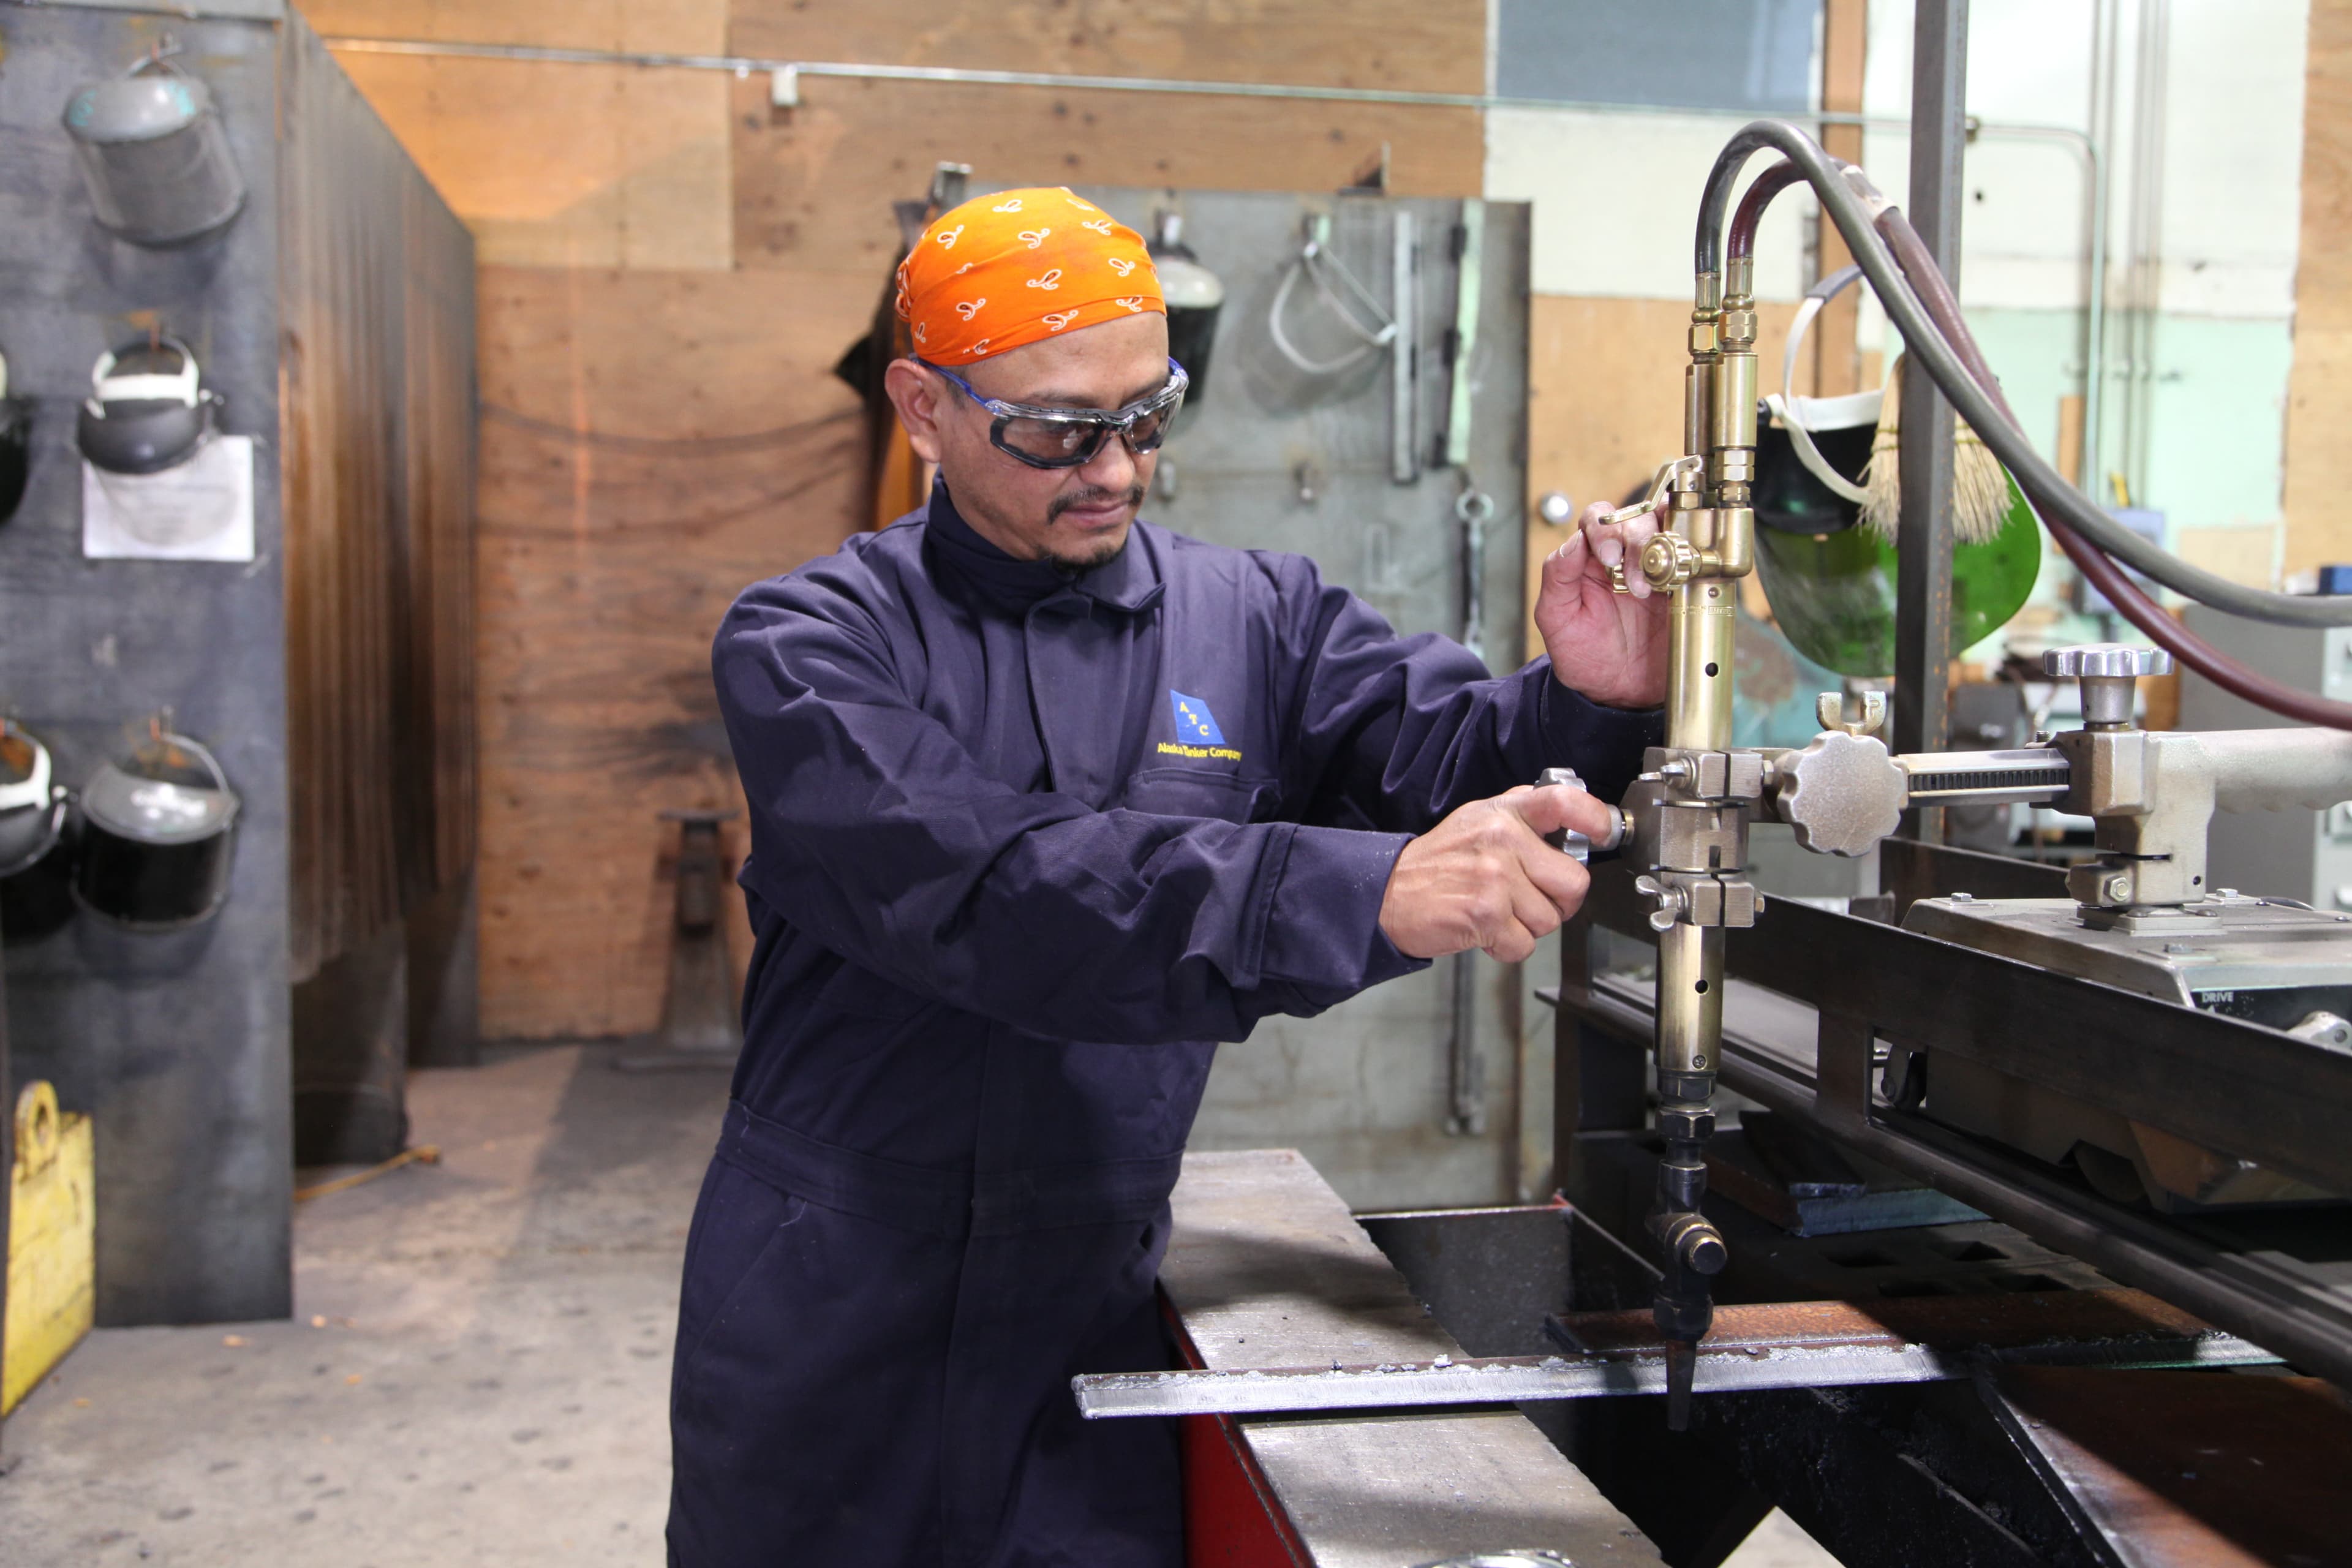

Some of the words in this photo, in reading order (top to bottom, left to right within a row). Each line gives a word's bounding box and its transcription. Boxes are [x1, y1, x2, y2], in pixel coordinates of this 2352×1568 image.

[1158, 742, 1183, 755] Alaska
[1183, 745, 1208, 758] Tanker
[1210, 748, 1242, 761] Company
[2203, 992, 2233, 1003] DRIVE
